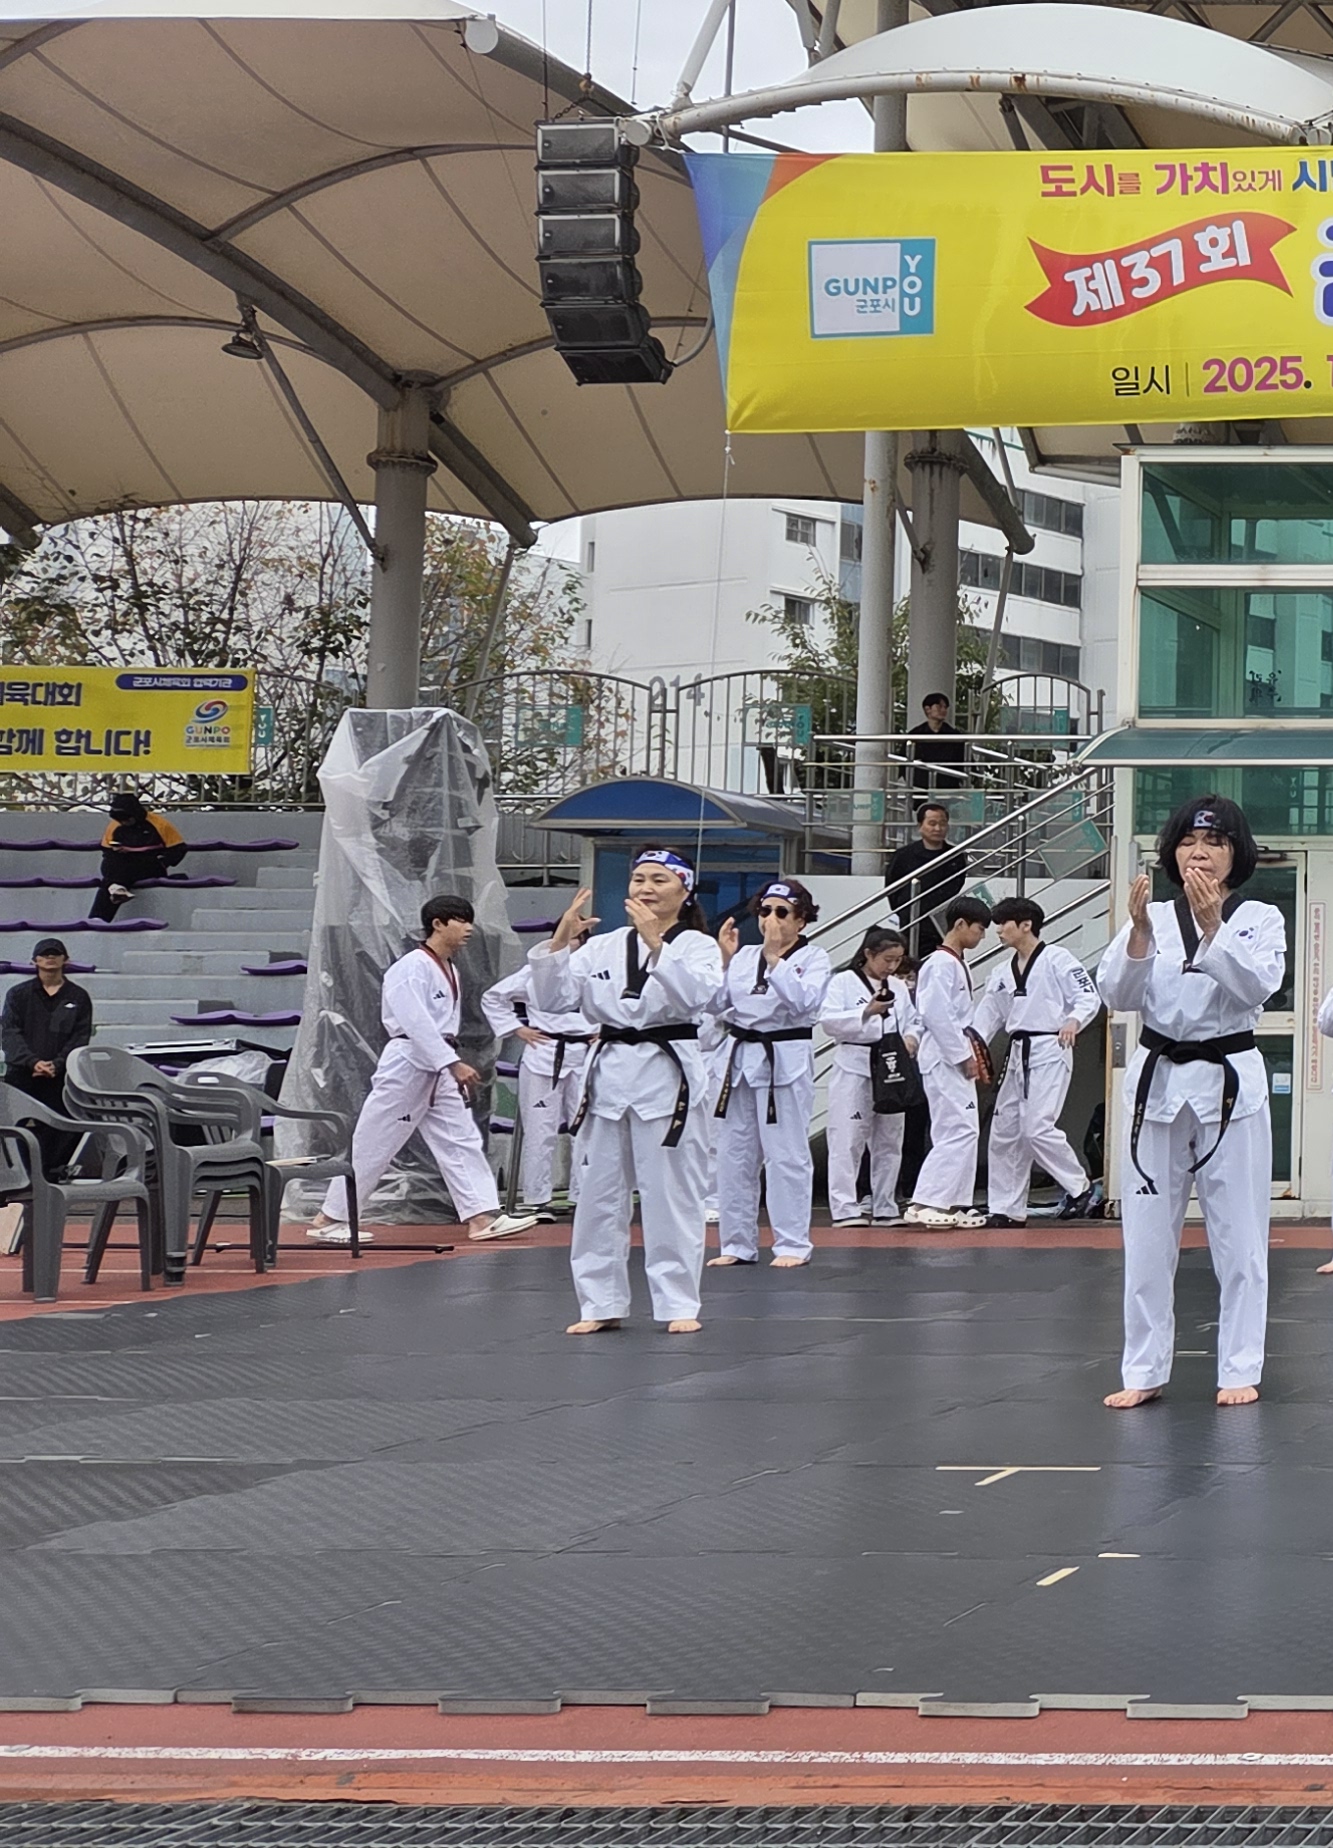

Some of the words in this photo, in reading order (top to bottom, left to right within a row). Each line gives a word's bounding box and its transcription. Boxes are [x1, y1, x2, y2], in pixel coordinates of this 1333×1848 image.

[1040, 163, 1142, 198] 도시를
[1154, 161, 1283, 195] 가치있게
[902, 254, 922, 317] YOU
[855, 297, 896, 314] 군포시
[1110, 364, 1171, 397] 일시
[1202, 355, 1313, 393] 2025.
[54, 728, 151, 757] 합니다!
[186, 725, 230, 735] GUNPO
